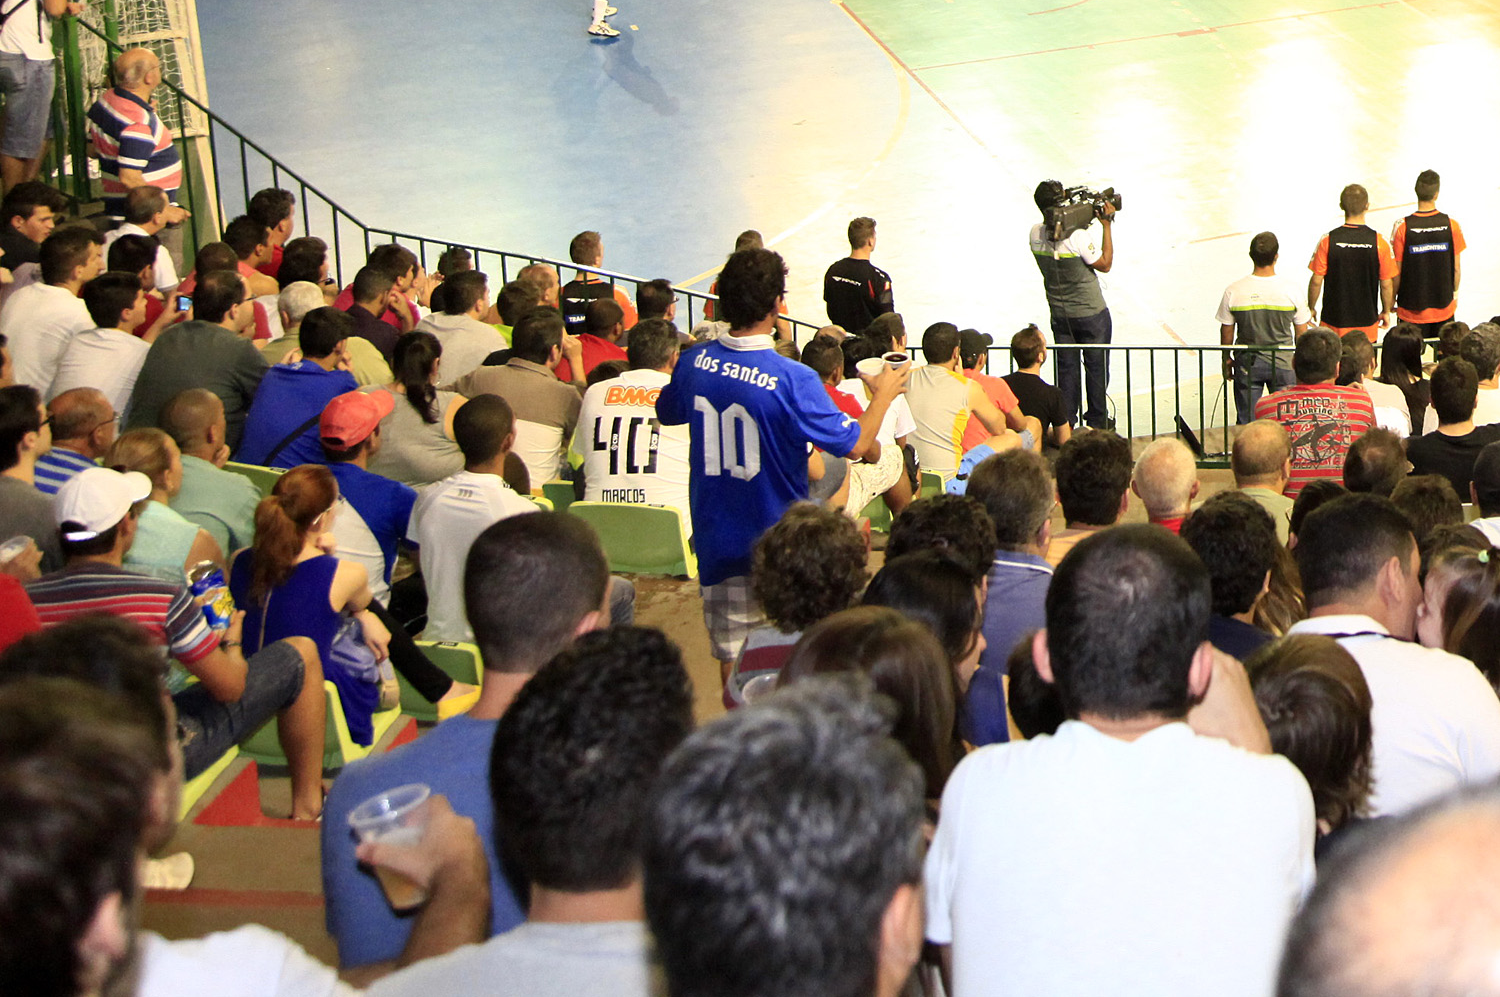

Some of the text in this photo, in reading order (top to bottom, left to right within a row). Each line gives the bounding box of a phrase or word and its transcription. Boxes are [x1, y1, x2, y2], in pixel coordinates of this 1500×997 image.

[1412, 244, 1446, 252] TRAMONTINA
[694, 349, 778, 390] dos santos
[605, 386, 660, 406] BMG
[594, 417, 660, 475] 40
[694, 395, 761, 482] 10
[602, 489, 645, 503] MARCOS
